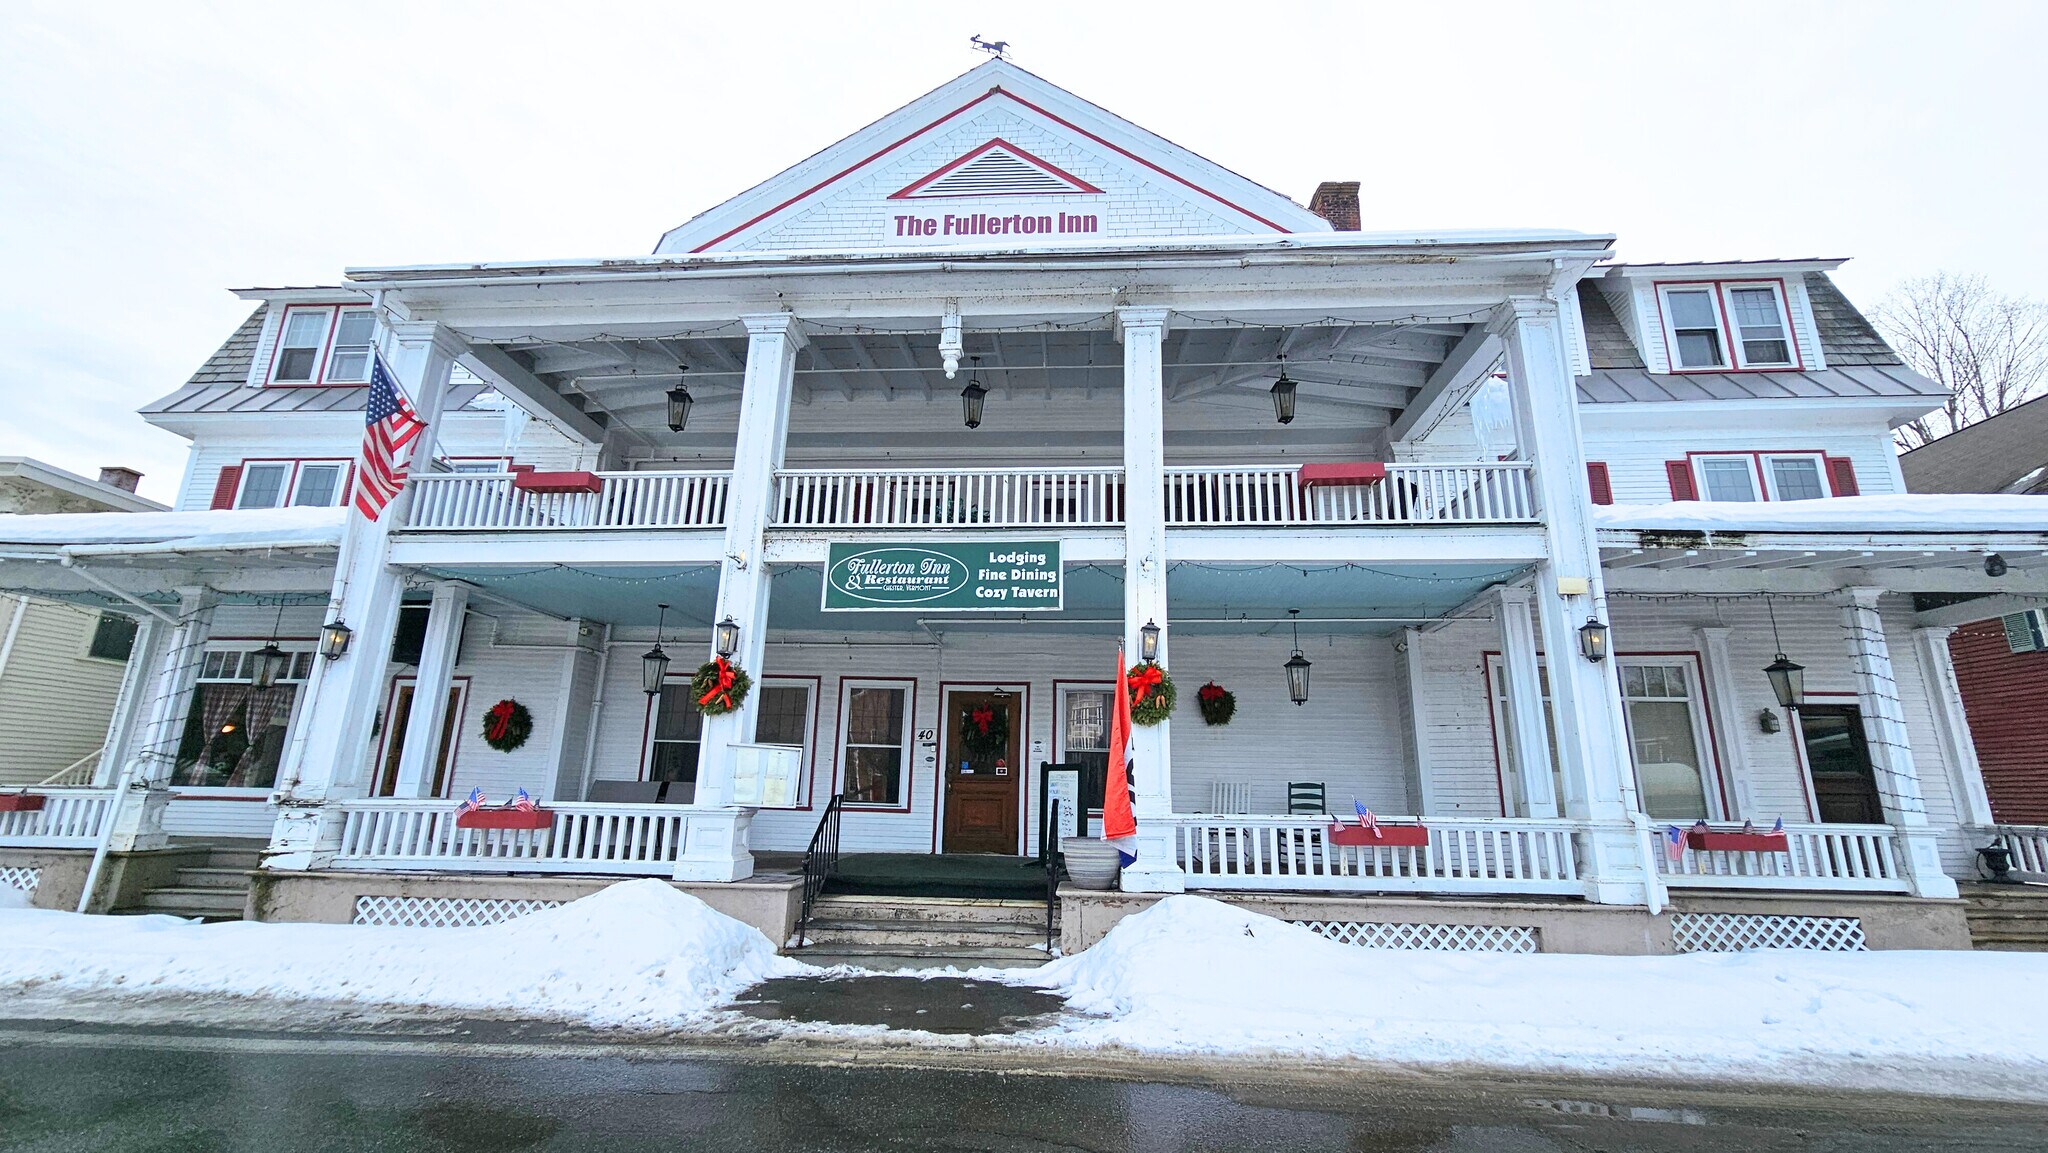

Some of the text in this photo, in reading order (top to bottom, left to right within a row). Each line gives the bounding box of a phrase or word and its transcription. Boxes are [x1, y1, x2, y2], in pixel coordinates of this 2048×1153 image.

[894, 212, 1098, 236] The Fullerton Inn
[847, 557, 951, 575] Fullerton Inn
[989, 551, 1047, 566] Lodging
[845, 572, 950, 590] & Restaurant
[978, 568, 1057, 583] Fine Dining
[975, 585, 1059, 600] Cozy Tavern
[918, 729, 933, 740] 40
